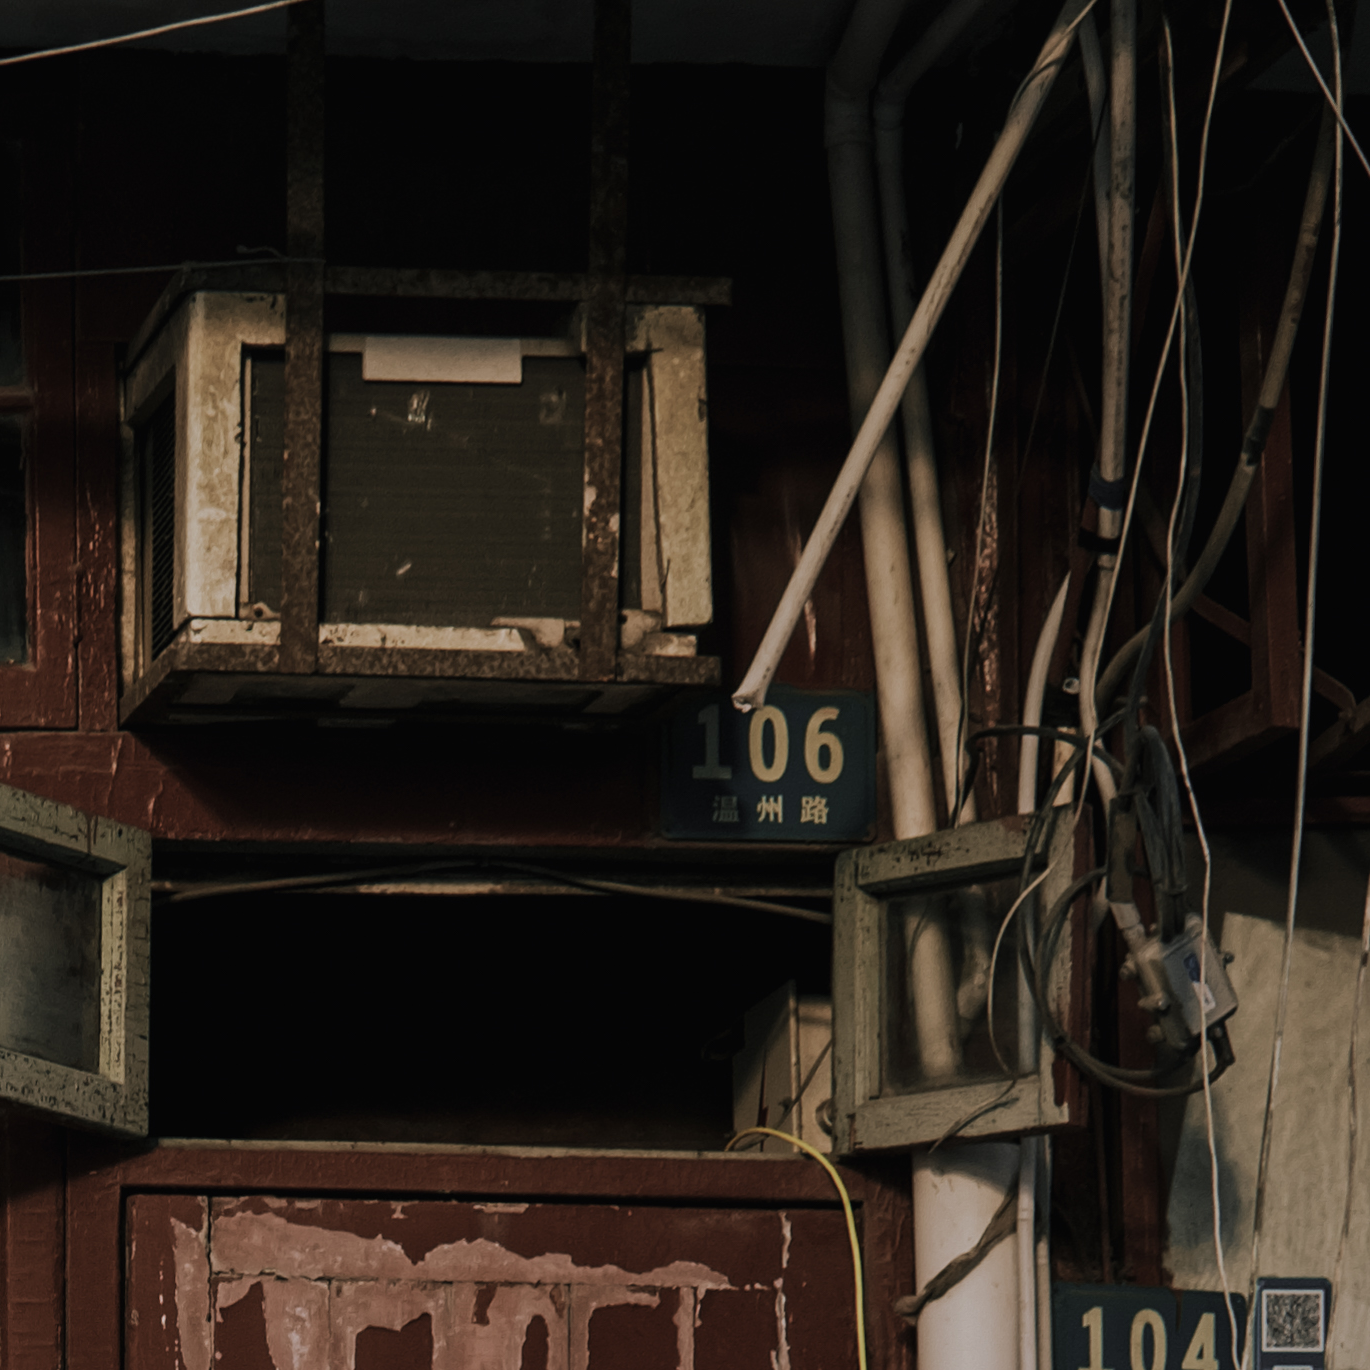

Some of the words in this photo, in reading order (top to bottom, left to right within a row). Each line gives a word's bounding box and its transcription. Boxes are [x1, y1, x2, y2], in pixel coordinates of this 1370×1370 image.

[692, 704, 844, 784] 106
[712, 795, 829, 824] 温州路
